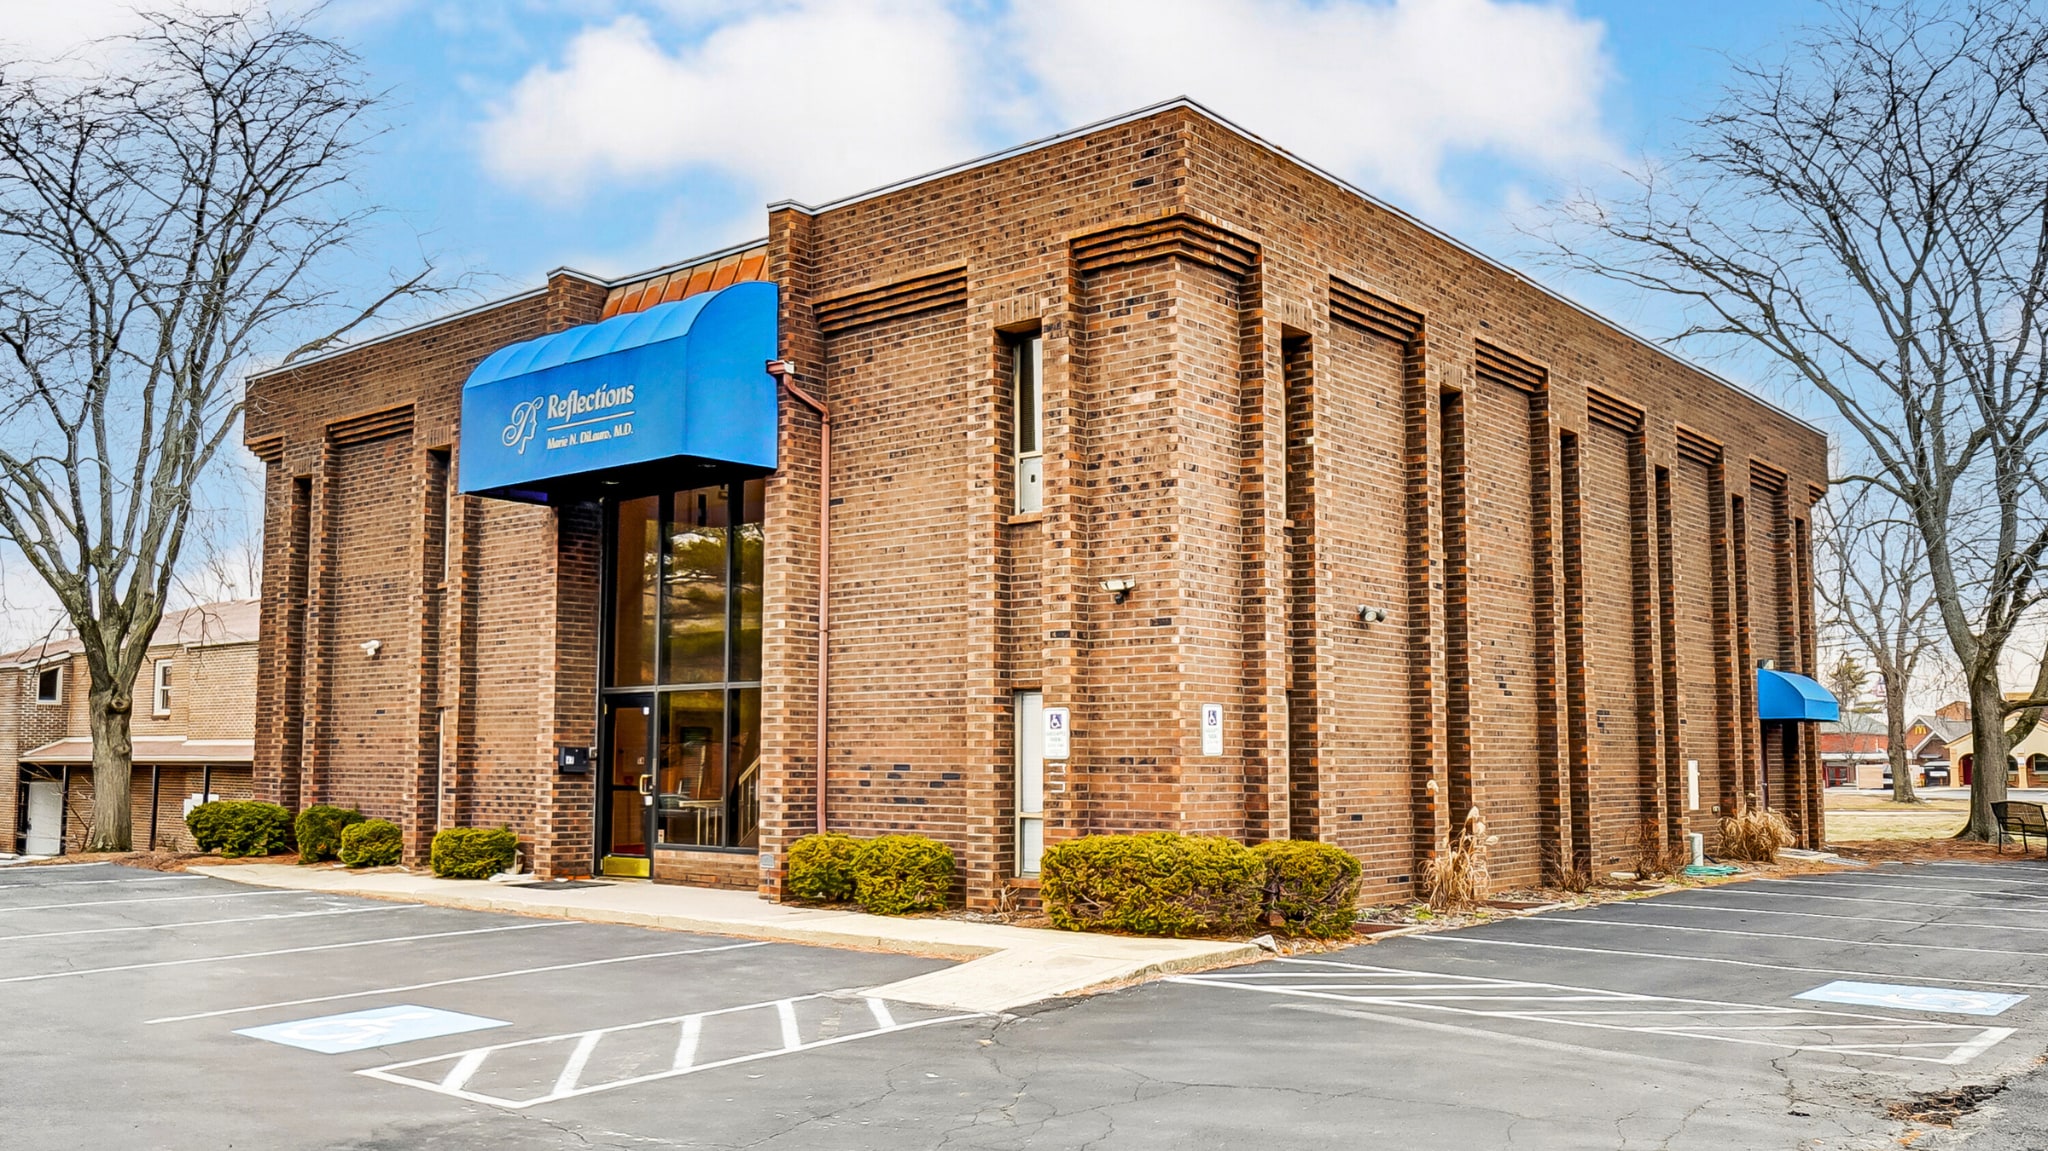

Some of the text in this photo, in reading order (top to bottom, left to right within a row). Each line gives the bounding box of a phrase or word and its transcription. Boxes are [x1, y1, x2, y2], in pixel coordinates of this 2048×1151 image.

[547, 384, 635, 422] Reflections
[569, 433, 578, 445] N.
[613, 422, 633, 437] M.D.
